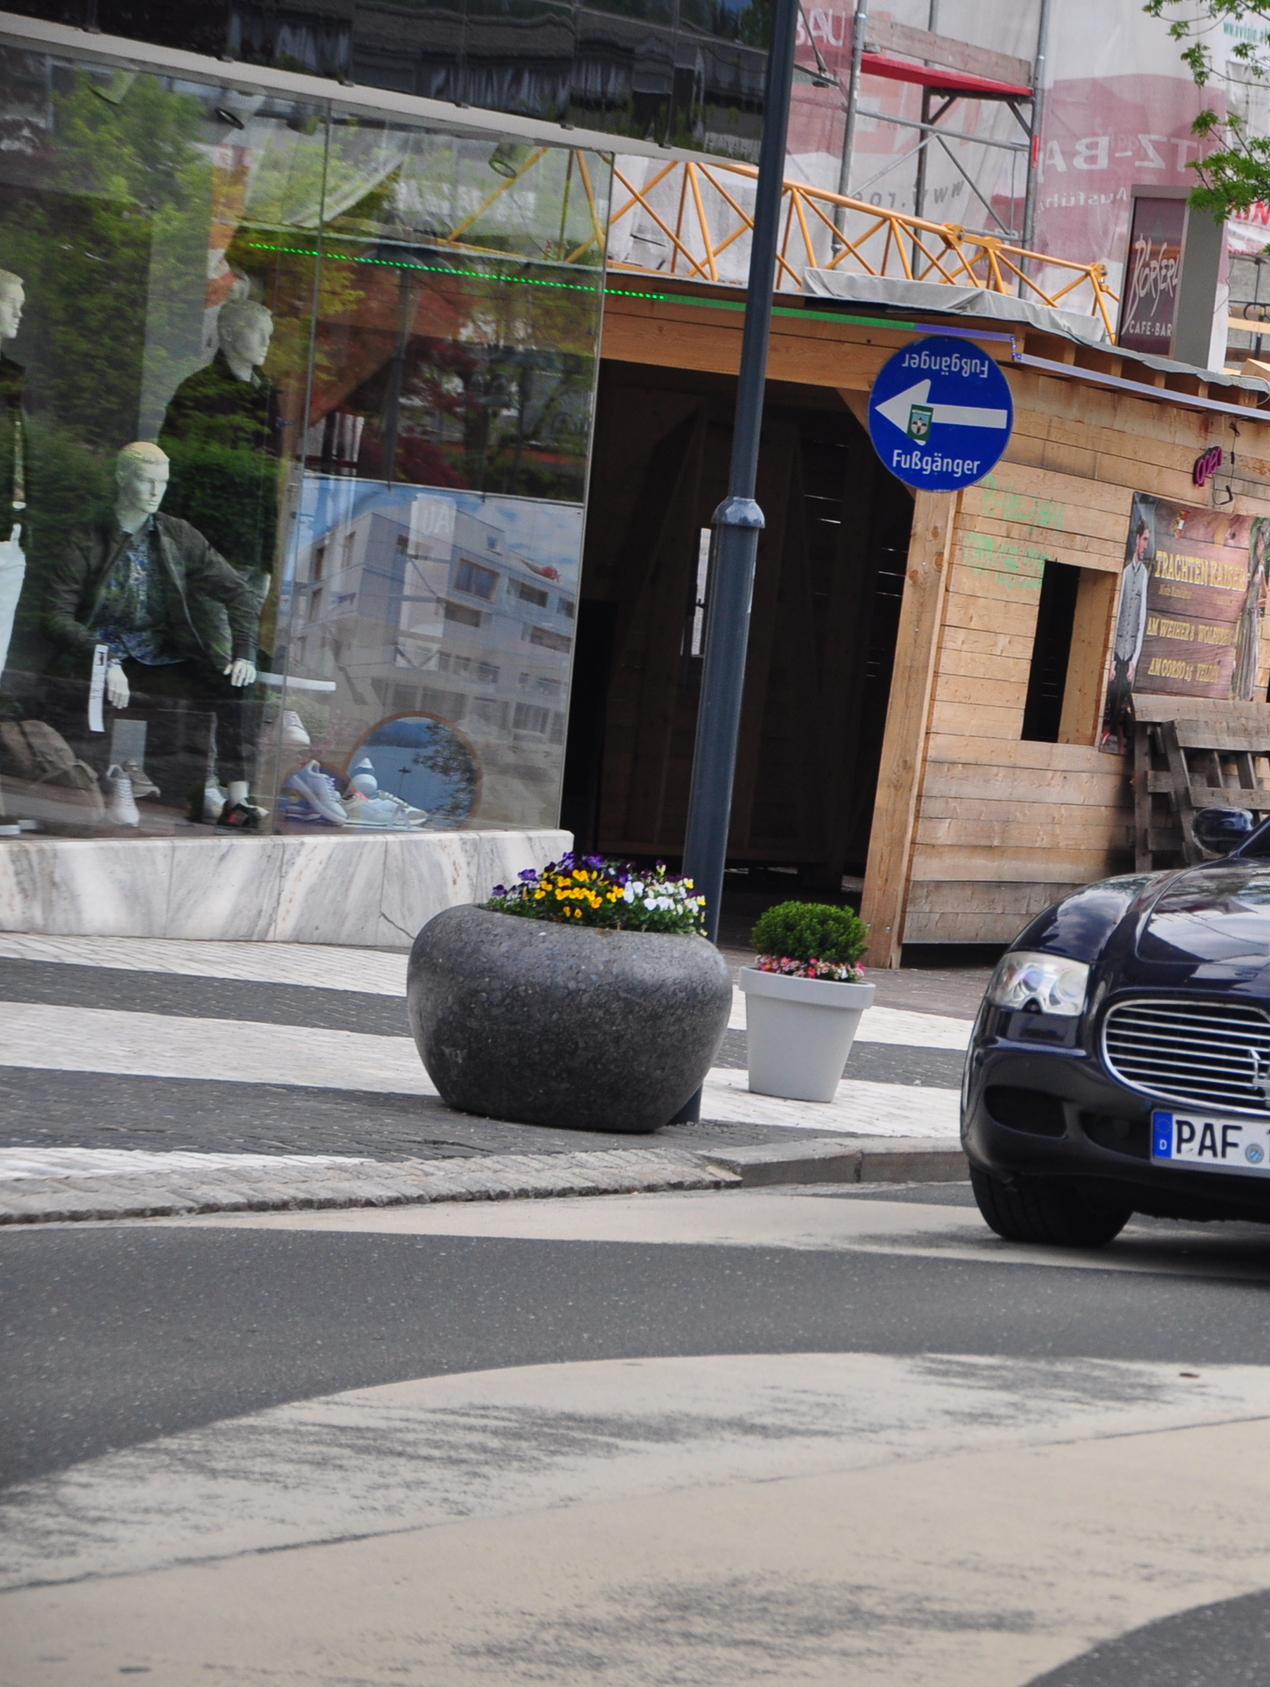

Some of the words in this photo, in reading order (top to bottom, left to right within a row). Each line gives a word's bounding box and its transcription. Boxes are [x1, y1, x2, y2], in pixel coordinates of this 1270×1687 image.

[1129, 319, 1173, 337] CAFE-BAR
[902, 350, 989, 379] Fußgänger
[892, 449, 981, 477] Fußgänger
[1159, 1139, 1168, 1150] D
[1175, 1119, 1243, 1158] PAF
